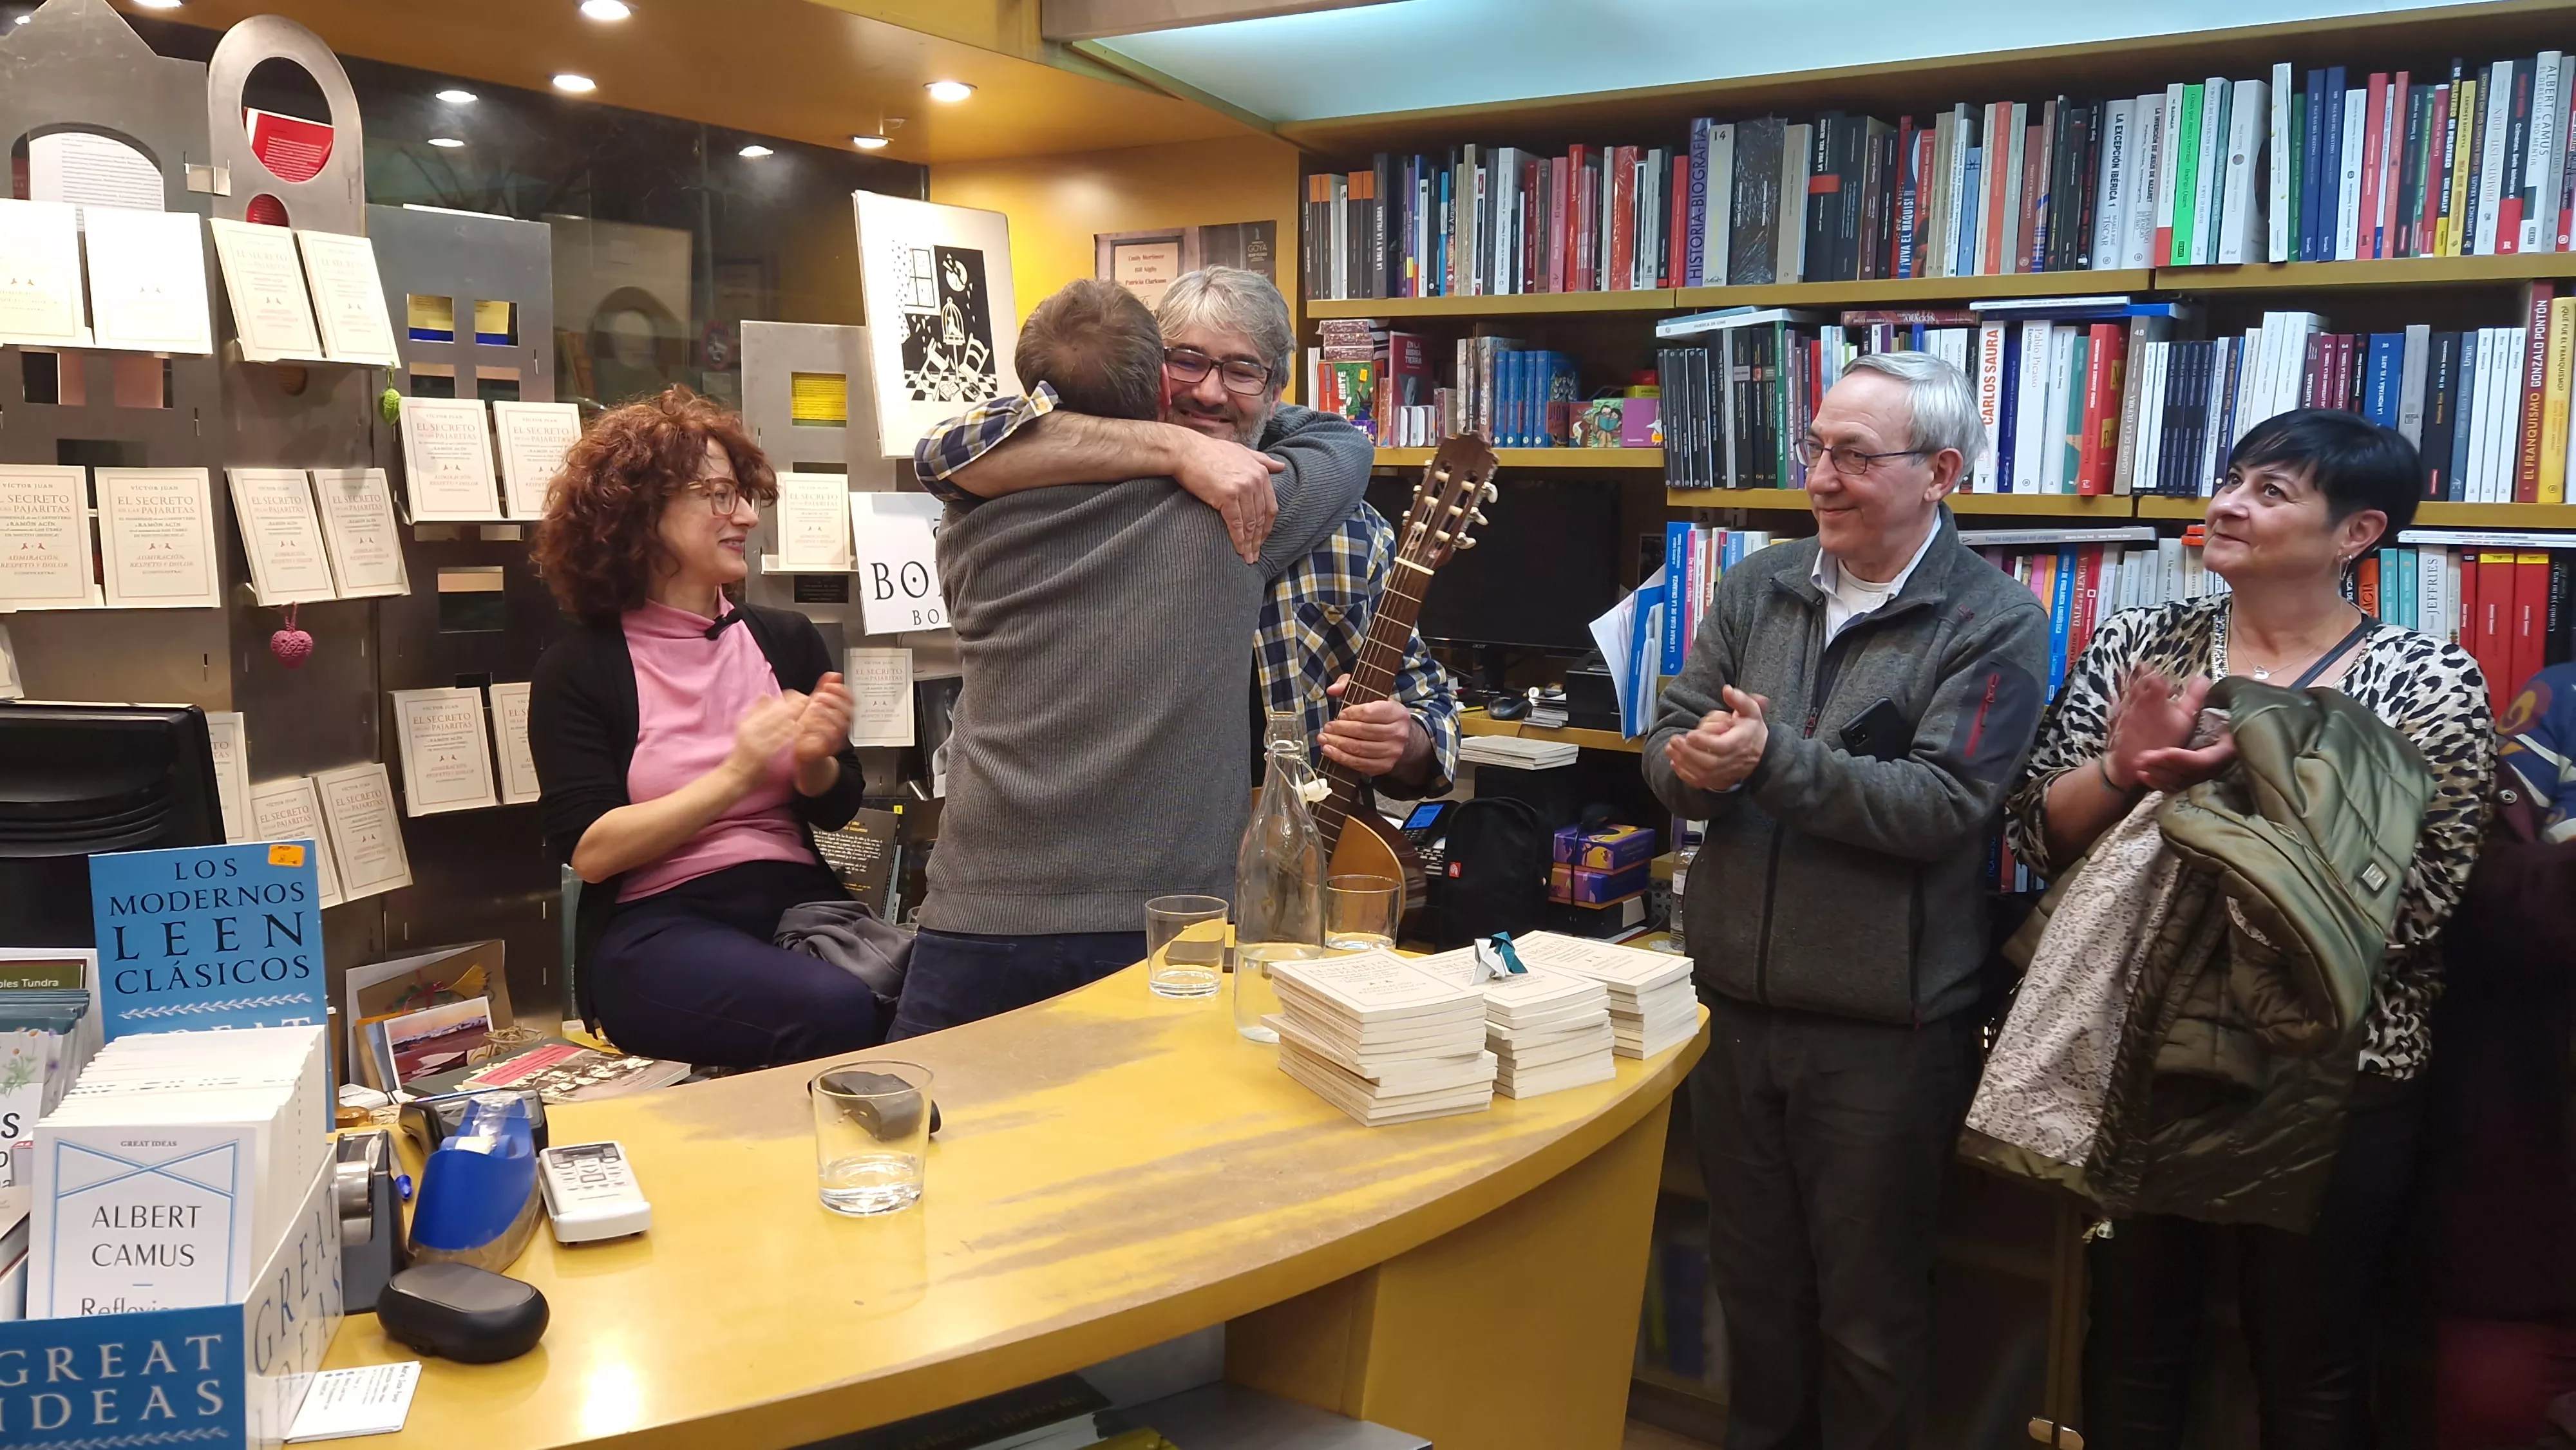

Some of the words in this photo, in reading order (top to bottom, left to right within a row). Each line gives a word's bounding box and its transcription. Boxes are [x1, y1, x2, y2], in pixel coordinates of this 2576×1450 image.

[2454, 67, 2460, 77] DE
[2540, 67, 2546, 75] EL
[2535, 77, 2545, 113] DERECHO
[2544, 66, 2557, 108] ALBERT
[2116, 114, 2124, 124] LA
[2208, 106, 2213, 115] DE
[1714, 130, 1727, 142] 14
[2448, 119, 2456, 129] EN
[2533, 123, 2541, 134] NO
[2539, 114, 2552, 155] CAMUS
[2112, 126, 2123, 168] EXCEPCIÓN
[2445, 131, 2455, 168] PELOTAZO
[2530, 137, 2539, 165] MENTIR
[2109, 171, 2120, 202] IBÉRICA
[2485, 162, 2497, 202] PRIMATES
[1901, 198, 1914, 231] MAQUIS!
[1901, 233, 1912, 242] EL
[2101, 216, 2111, 247] TÍSCAR
[1247, 244, 1268, 252] GOYA
[1899, 245, 1911, 266] ¡VIVA
[2533, 300, 2548, 339] PONTÓN
[2561, 306, 2569, 320] ¿QUÉ
[1985, 329, 1999, 373] SAURA
[2034, 328, 2043, 353] Pablo
[2463, 345, 2472, 366] Urtain
[2533, 342, 2544, 387] GONZALO
[2031, 357, 2041, 388] Picasso
[2557, 346, 2567, 391] FRANQUISMO?
[1981, 375, 1996, 425] CARLOS
[2376, 381, 2385, 407] MONTAÑA
[2126, 395, 2136, 422] GUERRA
[527, 426, 569, 435] SECRETO
[2124, 435, 2131, 444] DE
[2525, 393, 2540, 466] FRANQUISMO
[2121, 446, 2130, 474] LUGARES
[2523, 469, 2534, 480] EL
[8, 494, 70, 504] SECRETO
[13, 505, 70, 513] PAJARITAS
[118, 496, 133, 505] EL
[136, 496, 194, 505] SECRETO
[142, 506, 195, 514] PAJARITAS
[263, 496, 302, 505] SECRETO
[344, 495, 381, 504] SECRETO
[870, 561, 942, 600] BO
[2077, 557, 2088, 591] LENGUA
[2426, 558, 2441, 615] JEFFRIES
[912, 609, 951, 626] BO
[2072, 604, 2083, 626] DALE
[428, 713, 471, 722] SECRETO
[431, 722, 472, 731] PAJARITAS
[347, 790, 382, 804] SECRETO
[351, 798, 384, 811] PAJARITAS
[261, 814, 270, 824] EL
[271, 805, 309, 821] SECRETO
[276, 815, 311, 828] PAJARITAS
[175, 858, 238, 881] LOS
[109, 881, 305, 917] MODERNOS
[112, 911, 305, 961] LEEN
[114, 955, 310, 994] CLÁSICOS
[91, 1205, 202, 1229] ALBERT
[91, 1243, 195, 1267] CAMUS
[254, 1183, 335, 1377] GREAT
[0, 1334, 223, 1387] GREAT
